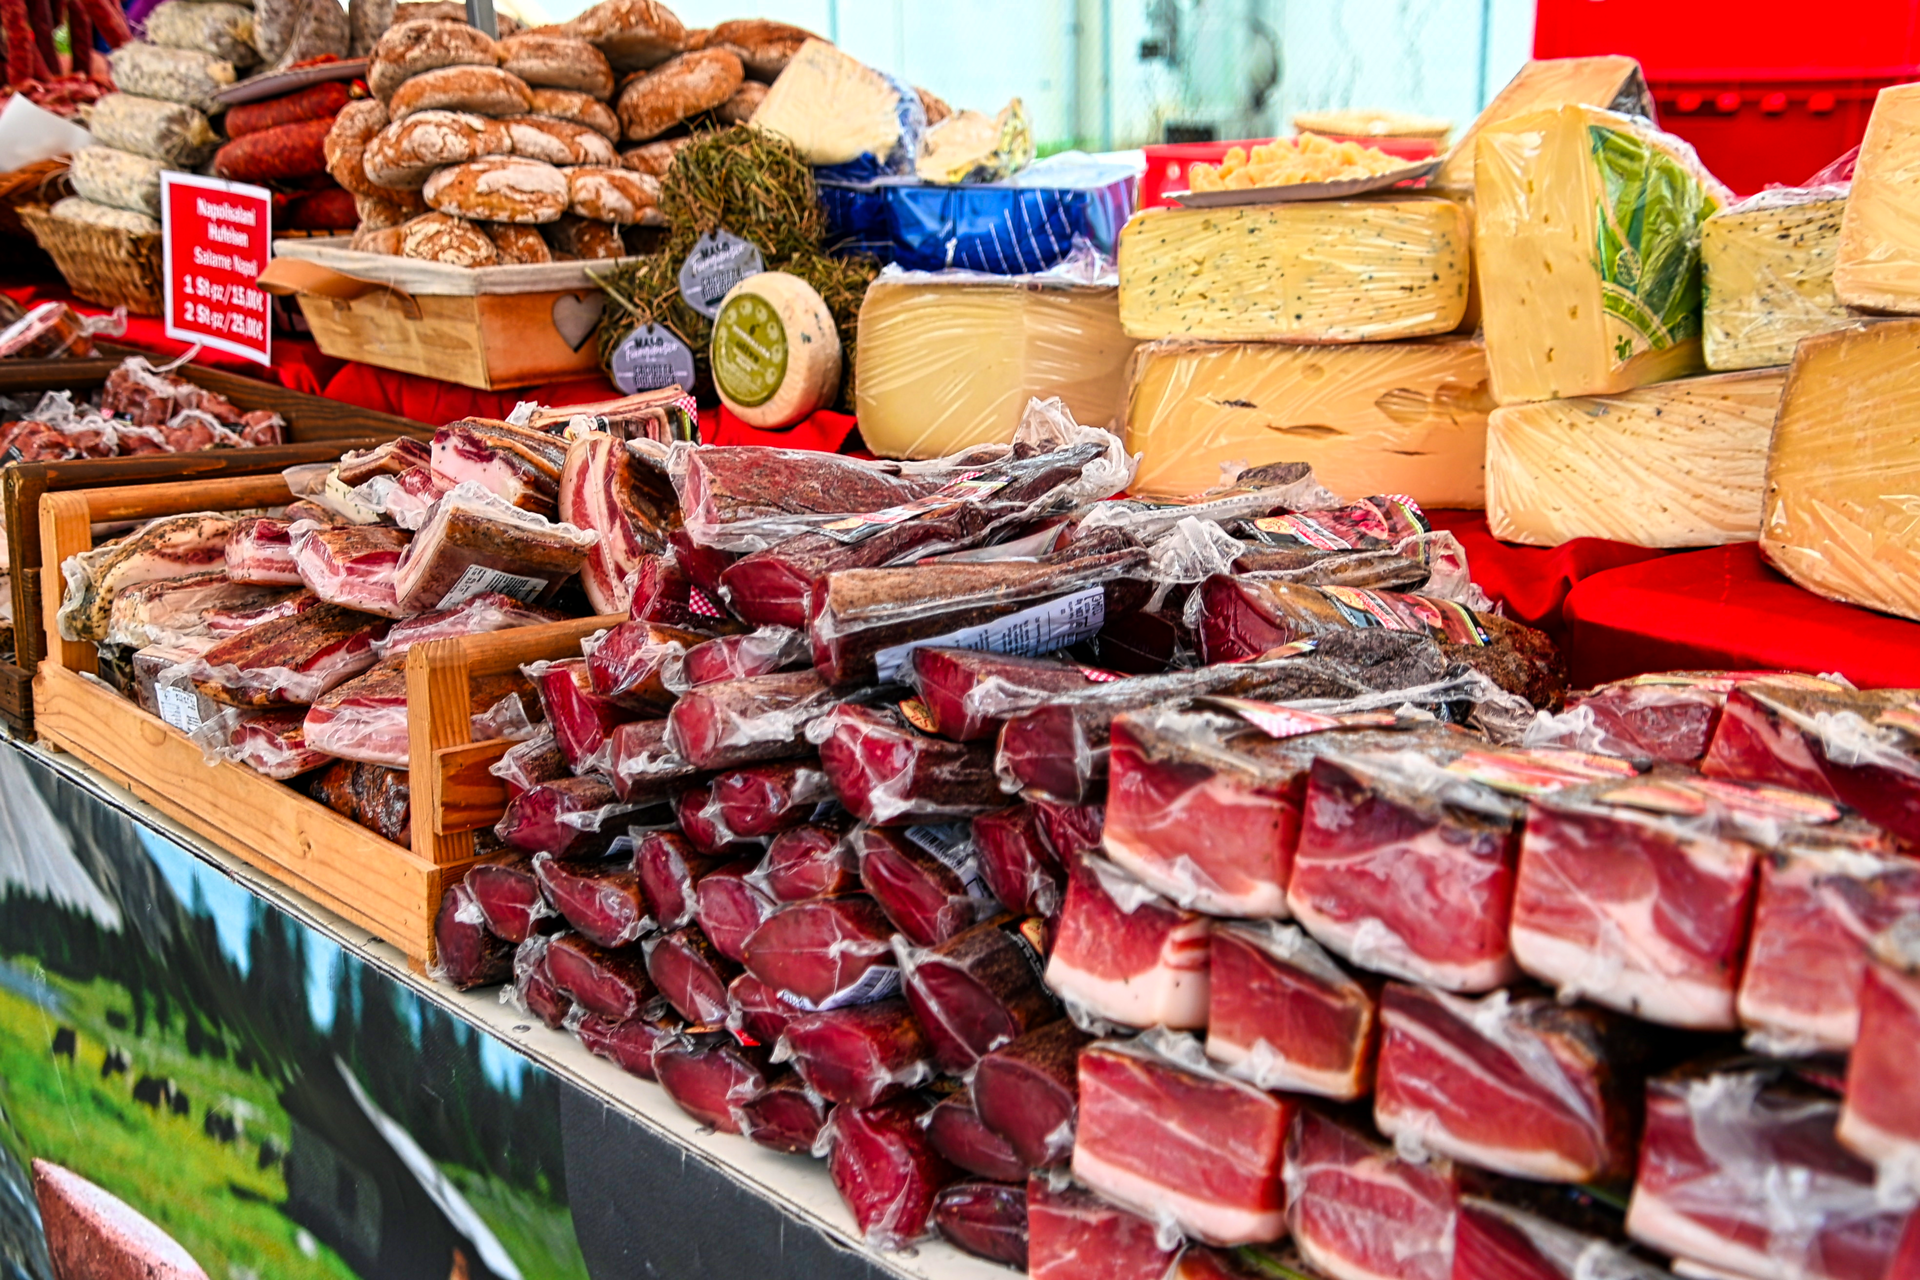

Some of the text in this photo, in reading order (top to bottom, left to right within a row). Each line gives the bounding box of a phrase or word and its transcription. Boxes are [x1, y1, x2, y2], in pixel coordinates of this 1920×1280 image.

[196, 197, 256, 227] Napolisalami
[207, 221, 249, 248] Hufeisen
[193, 245, 258, 278] Salame Napoli
[183, 274, 195, 295] 1
[184, 301, 195, 322] 2
[635, 337, 664, 348] MASO
